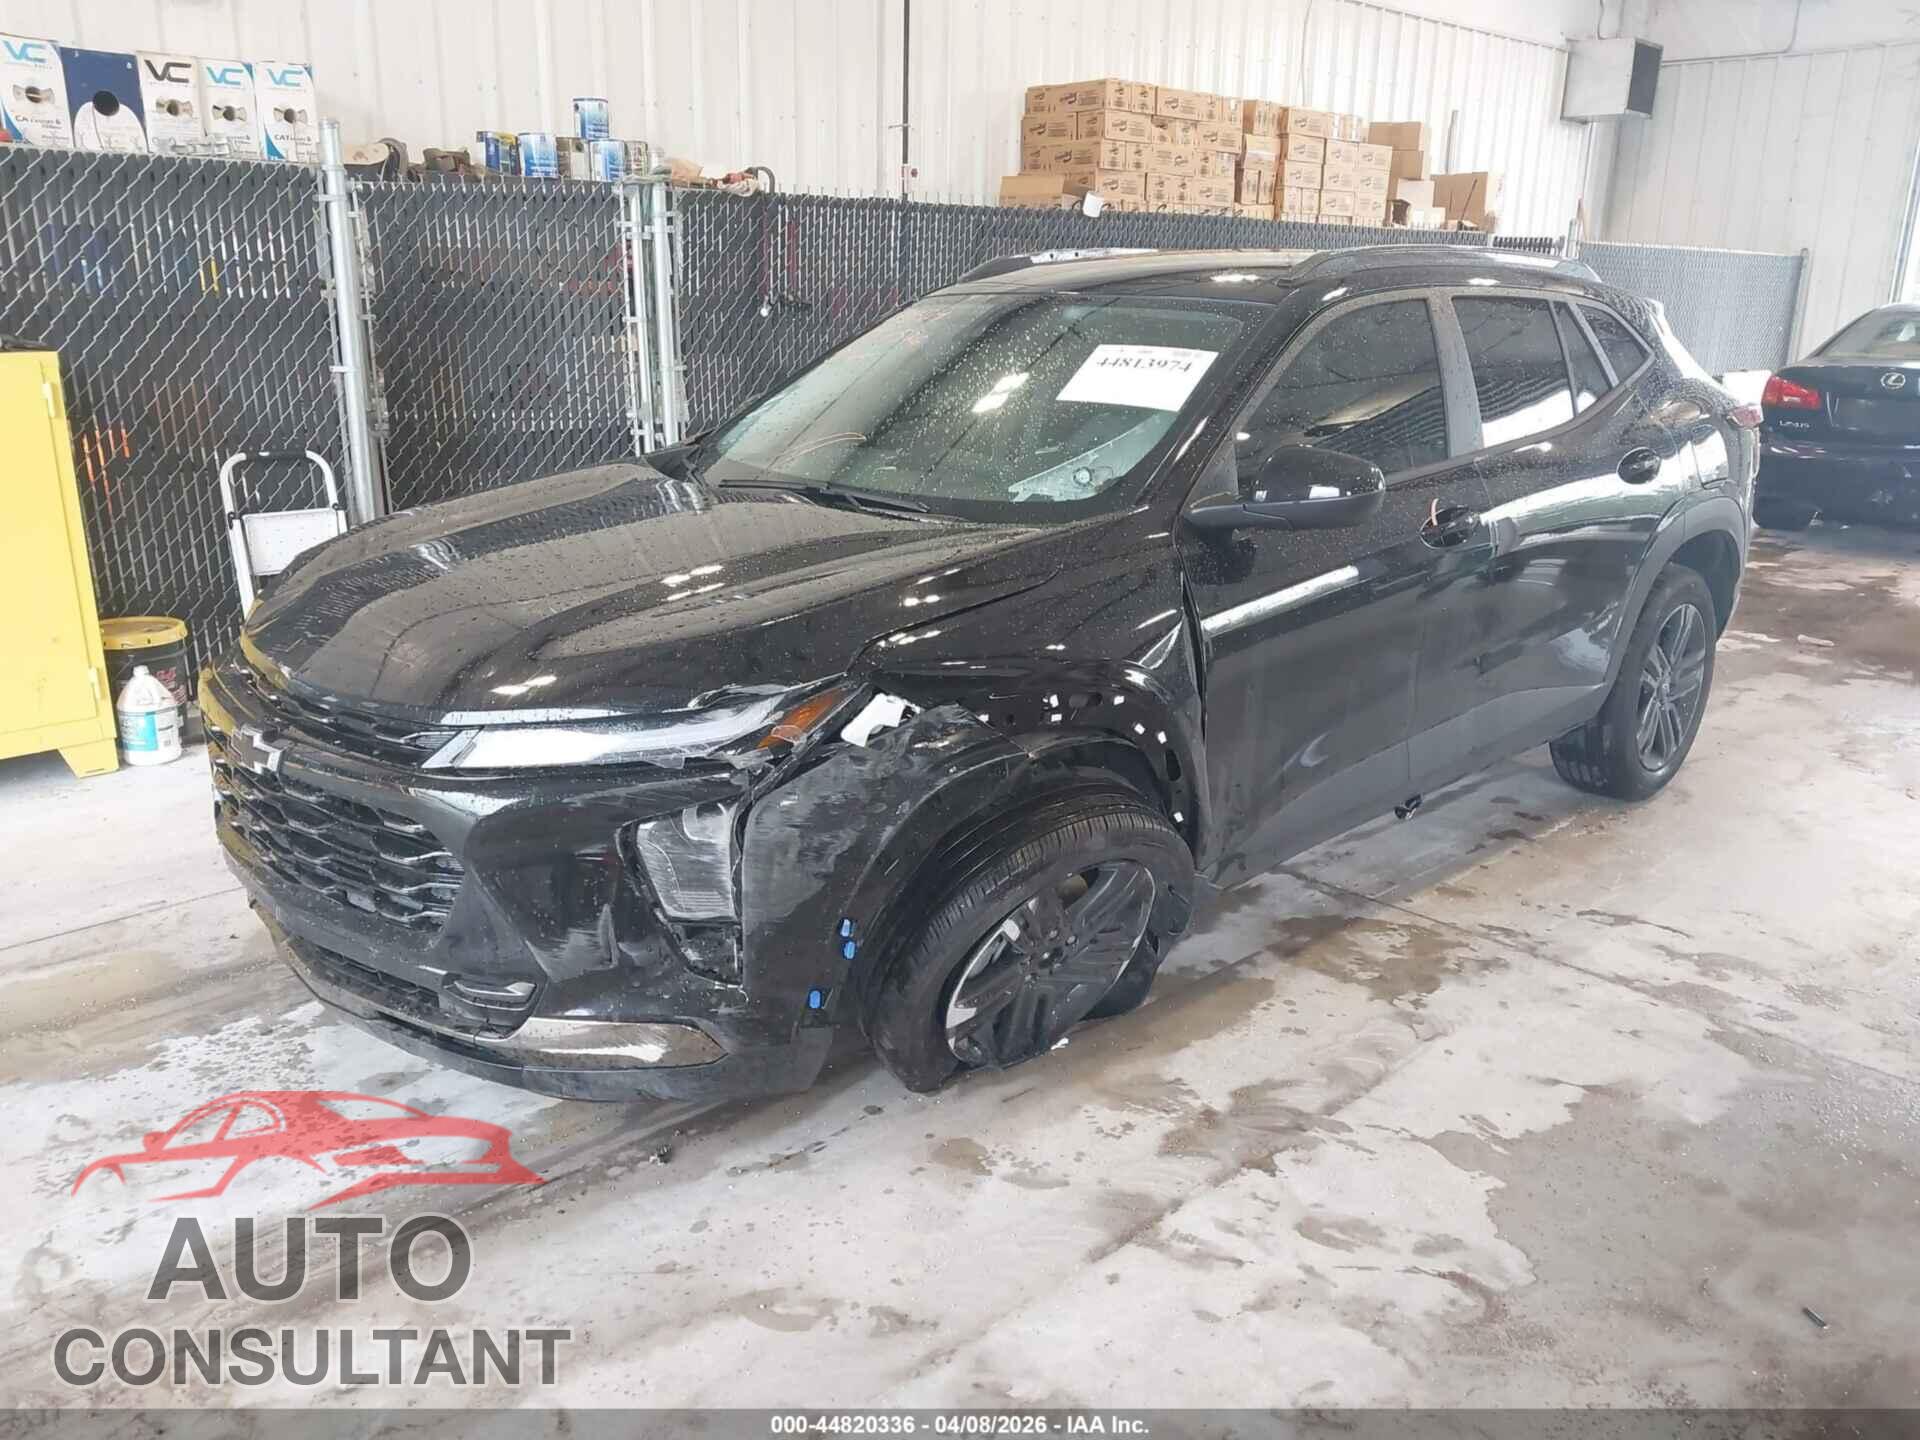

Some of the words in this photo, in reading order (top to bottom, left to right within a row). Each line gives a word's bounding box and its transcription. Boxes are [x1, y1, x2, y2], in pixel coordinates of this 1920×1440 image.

[2, 39, 47, 63] VC
[144, 59, 192, 84] VC
[206, 65, 244, 86] VC
[266, 67, 304, 87] VC
[1097, 356, 1193, 373] 44813974
